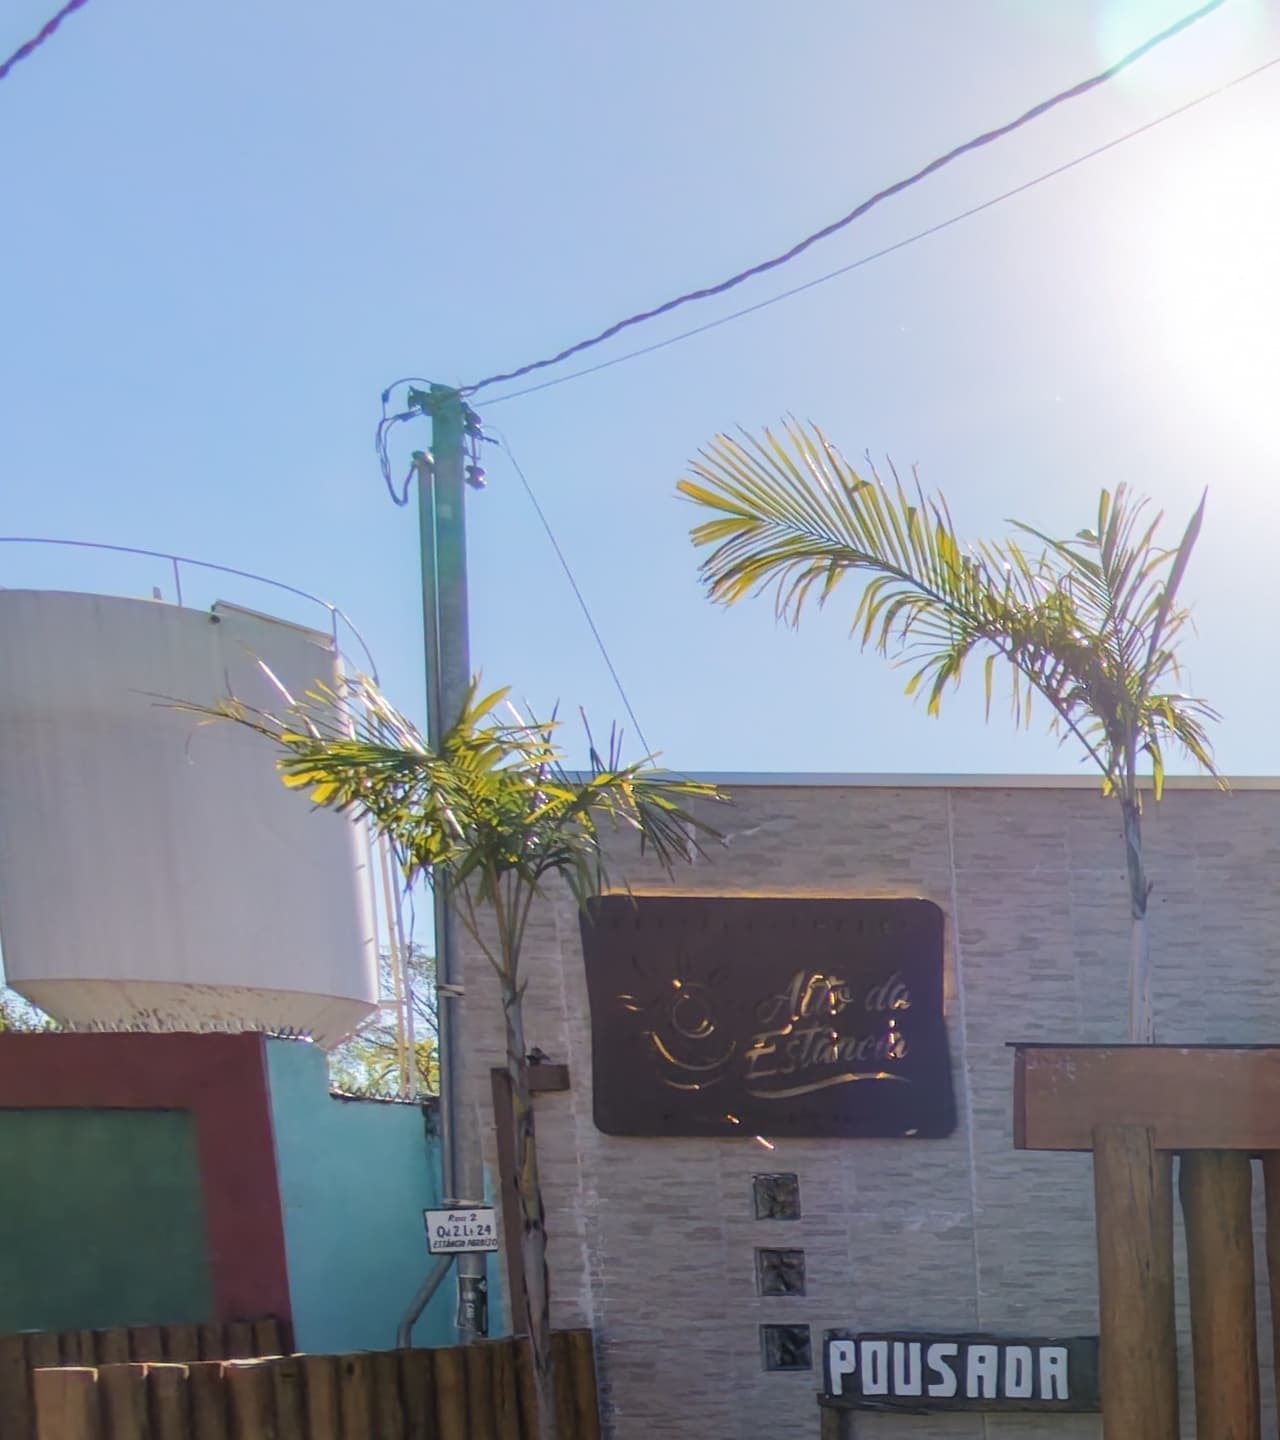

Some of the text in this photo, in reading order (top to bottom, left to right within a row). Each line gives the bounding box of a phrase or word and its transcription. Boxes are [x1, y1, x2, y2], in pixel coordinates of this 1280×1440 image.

[756, 970, 912, 1024] Alto da
[452, 1224, 461, 1237] 2
[477, 1223, 492, 1236] 24
[829, 1339, 1070, 1400] POUSADA
